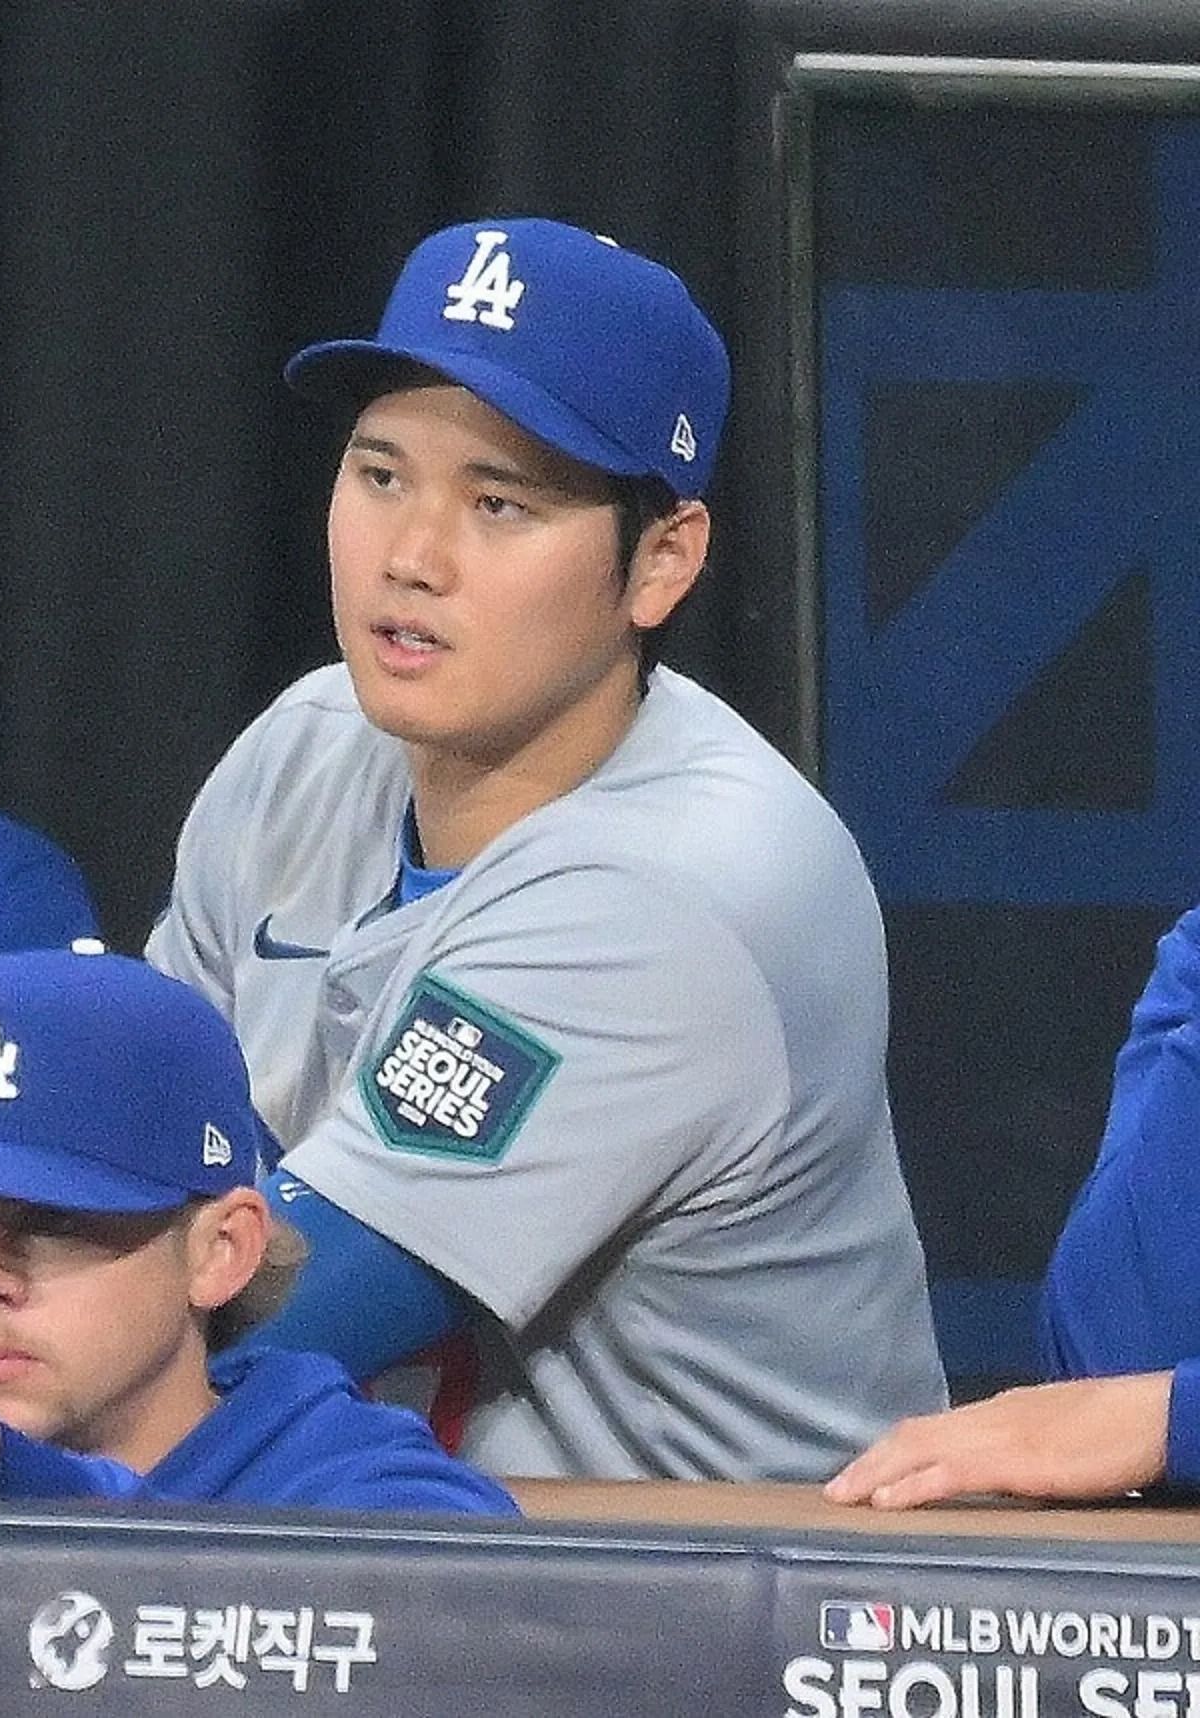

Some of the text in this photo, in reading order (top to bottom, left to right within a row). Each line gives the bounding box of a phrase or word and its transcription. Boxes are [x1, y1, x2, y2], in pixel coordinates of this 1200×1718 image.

[443, 230, 525, 331] LA
[376, 1055, 485, 1138] SERIES
[395, 1030, 490, 1113] SEOUL
[124, 1603, 377, 1693] 로켓직구
[901, 1606, 1001, 1653] MLB
[1005, 1610, 1180, 1660] WORLD
